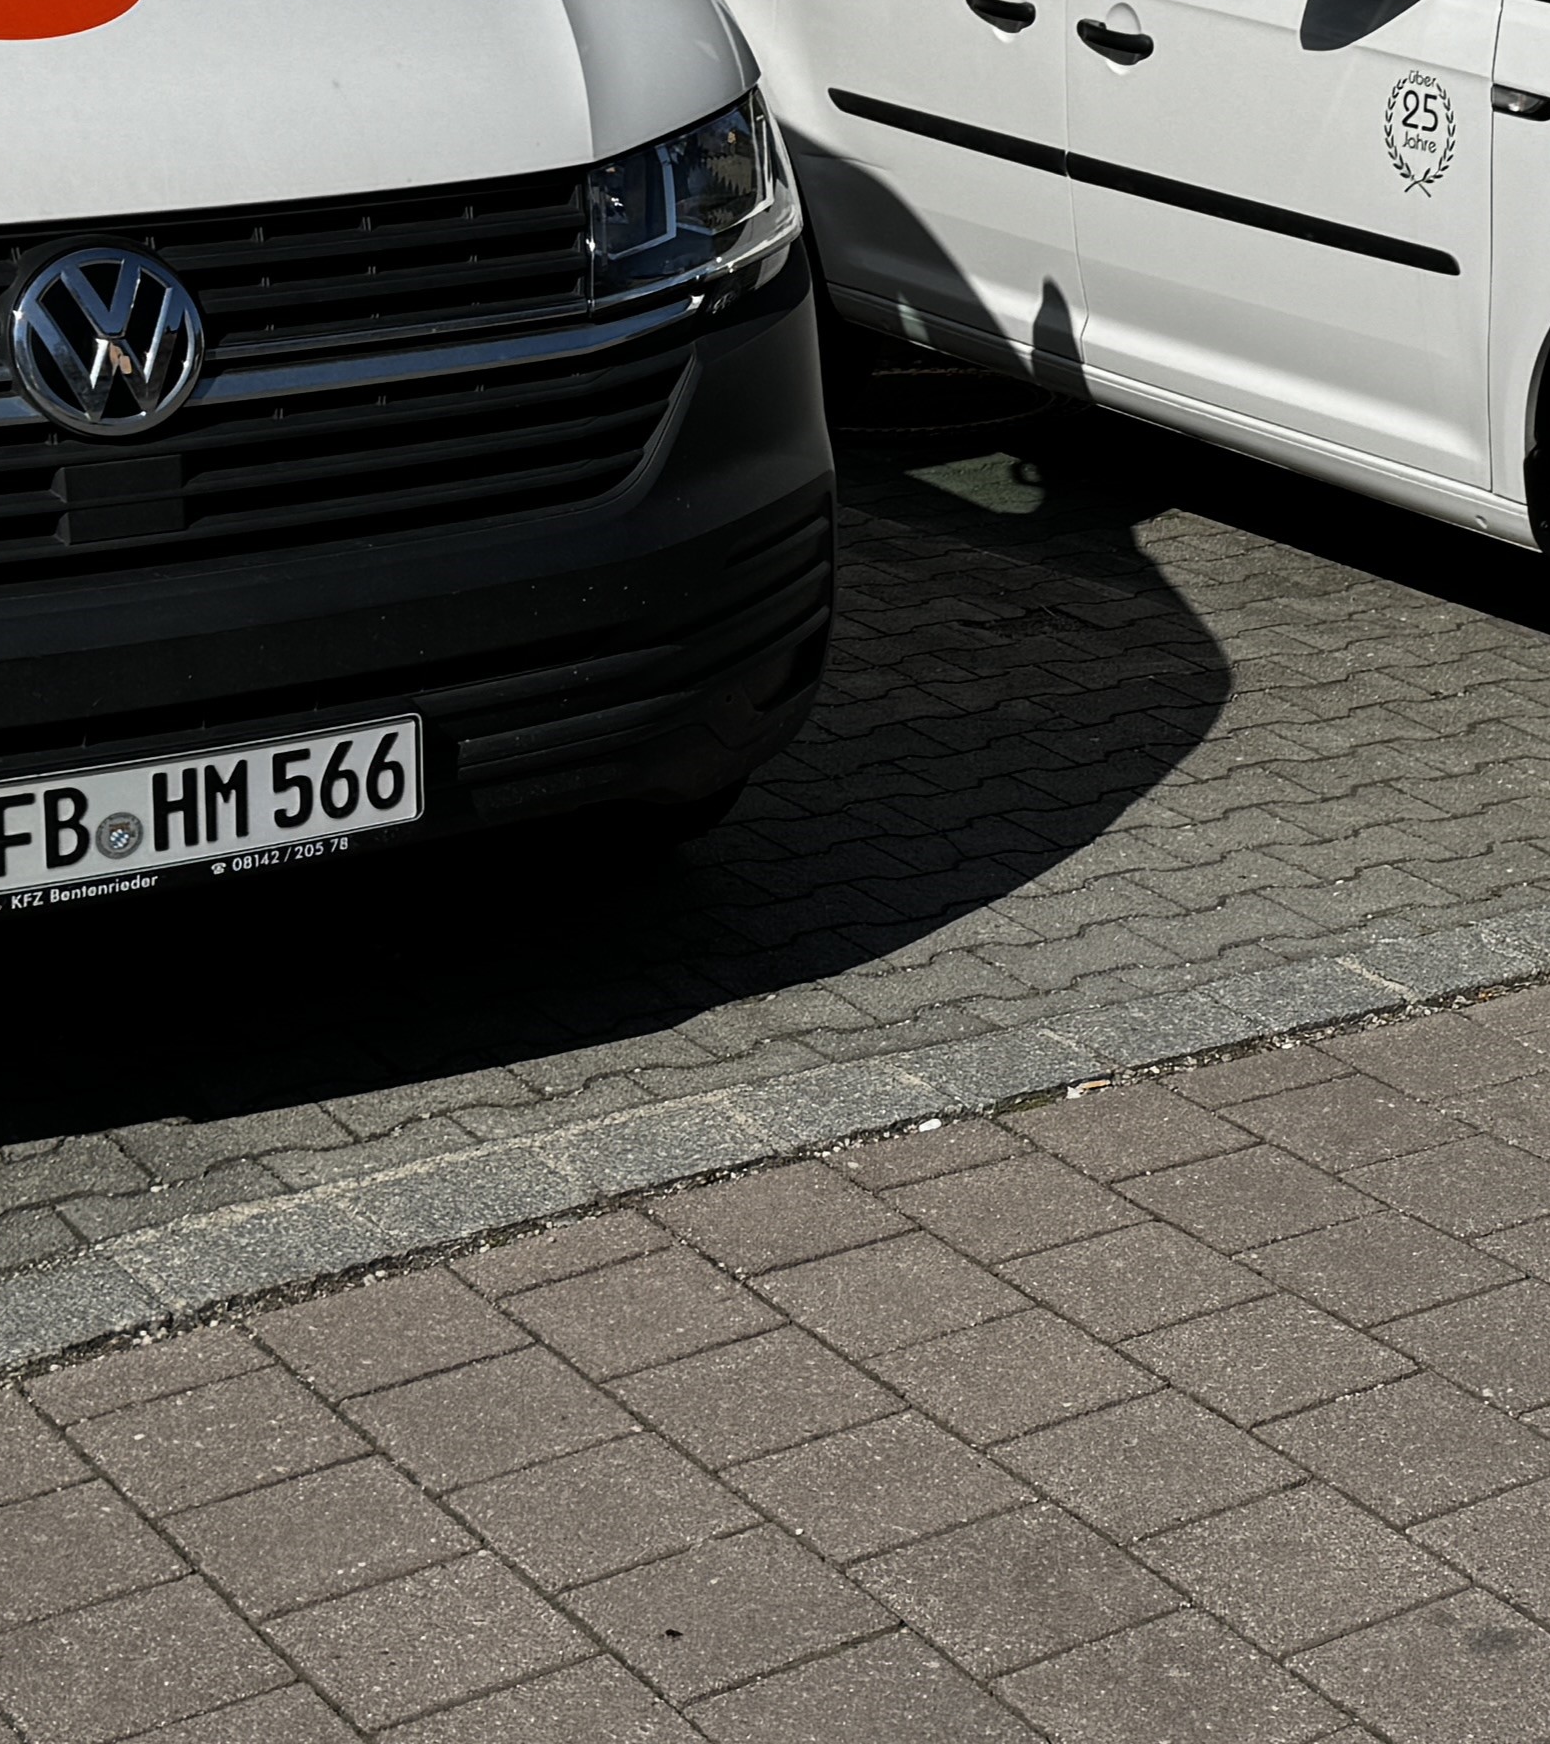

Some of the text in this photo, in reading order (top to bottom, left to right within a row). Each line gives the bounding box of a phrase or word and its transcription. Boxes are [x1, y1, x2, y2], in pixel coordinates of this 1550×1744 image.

[1408, 70, 1437, 87] über
[1402, 90, 1439, 132] 25
[1402, 131, 1437, 154] Jahre
[151, 759, 249, 852] HM
[272, 732, 406, 829] 566
[10, 891, 44, 910] KFZ
[50, 873, 159, 904] Bentenrieder
[231, 850, 281, 873] 08142
[294, 842, 324, 860] 205
[330, 836, 350, 853] 78
